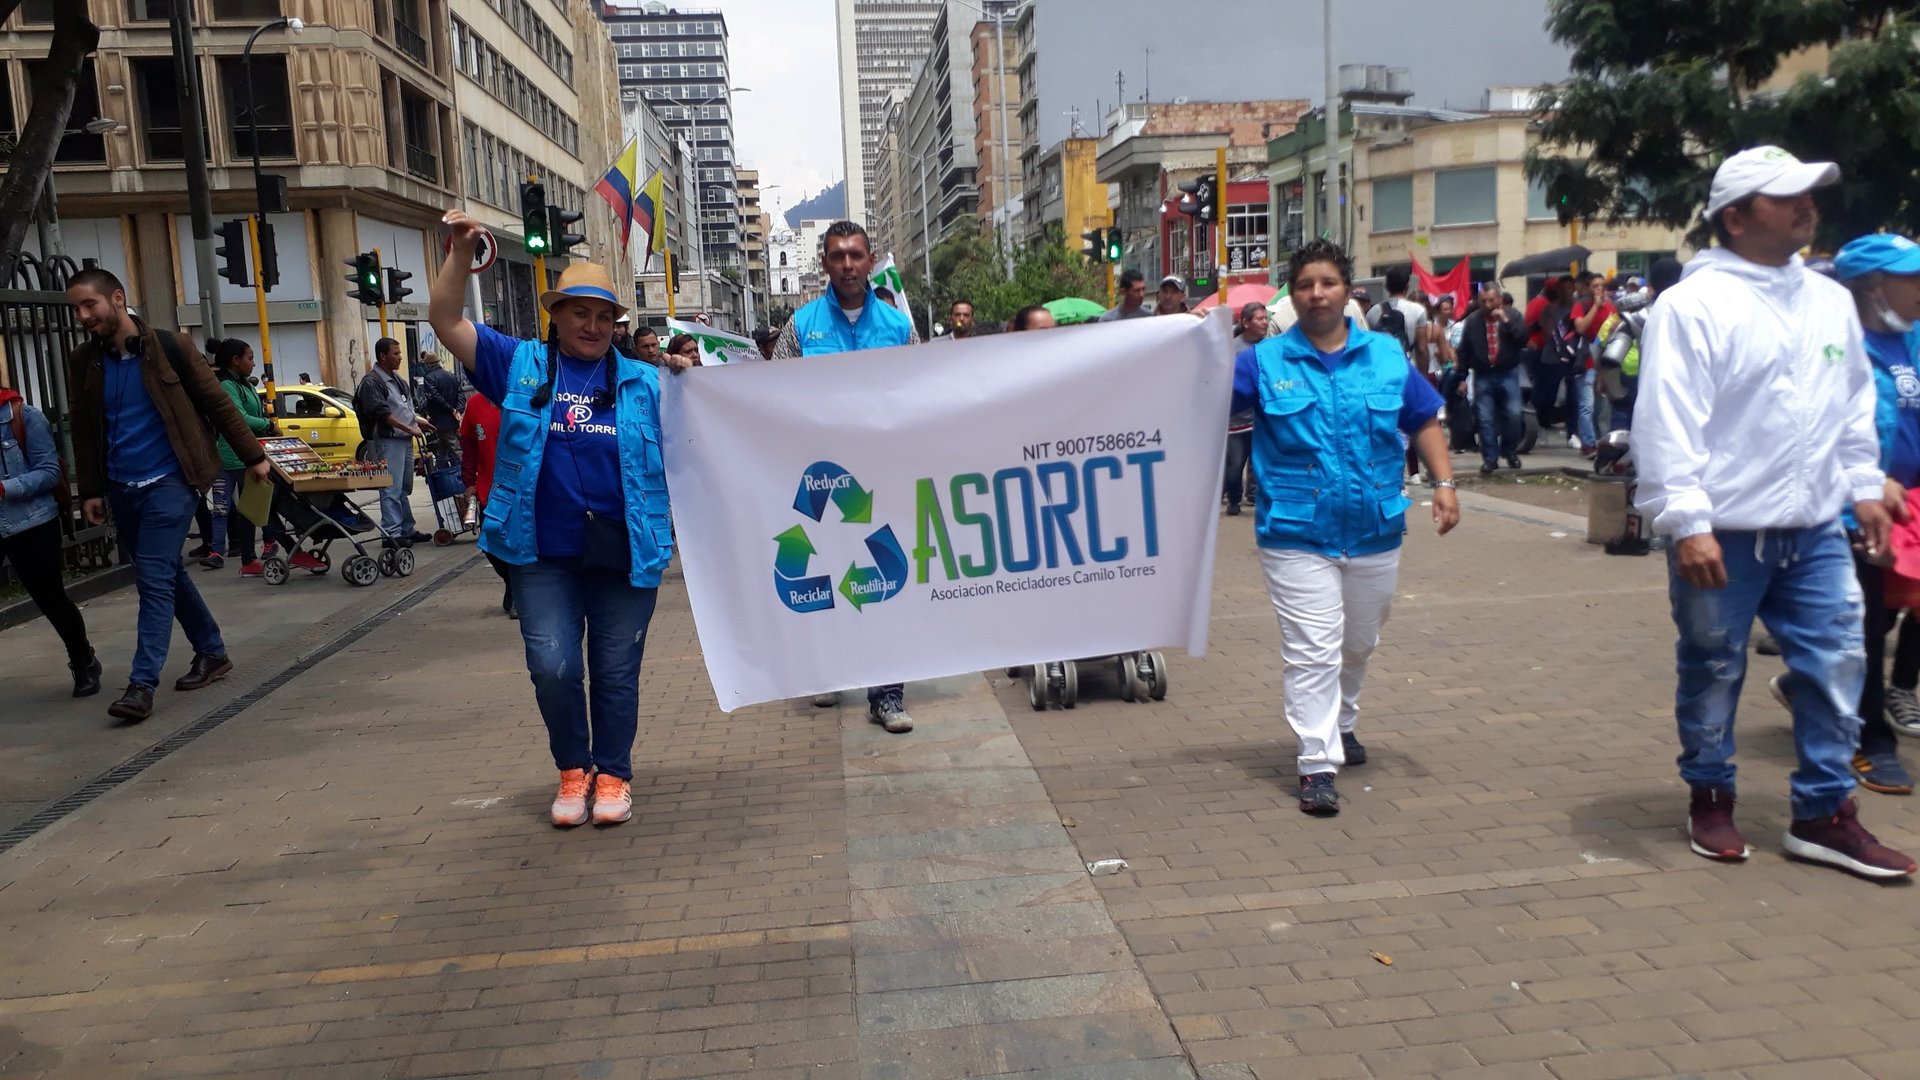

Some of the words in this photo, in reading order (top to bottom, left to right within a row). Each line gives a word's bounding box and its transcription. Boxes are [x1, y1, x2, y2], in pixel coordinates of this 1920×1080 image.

[1022, 442, 1051, 461] NIT
[1056, 429, 1162, 457] 900758662-4
[804, 473, 851, 491] Reducir
[913, 450, 1166, 584] ASORCT
[849, 578, 898, 595] Reutilizar
[930, 582, 994, 601] Asociacion
[996, 575, 1071, 593] Recicladores
[1073, 566, 1115, 584] Camilo
[1118, 563, 1156, 579] Torres
[789, 587, 831, 605] Reciclar
